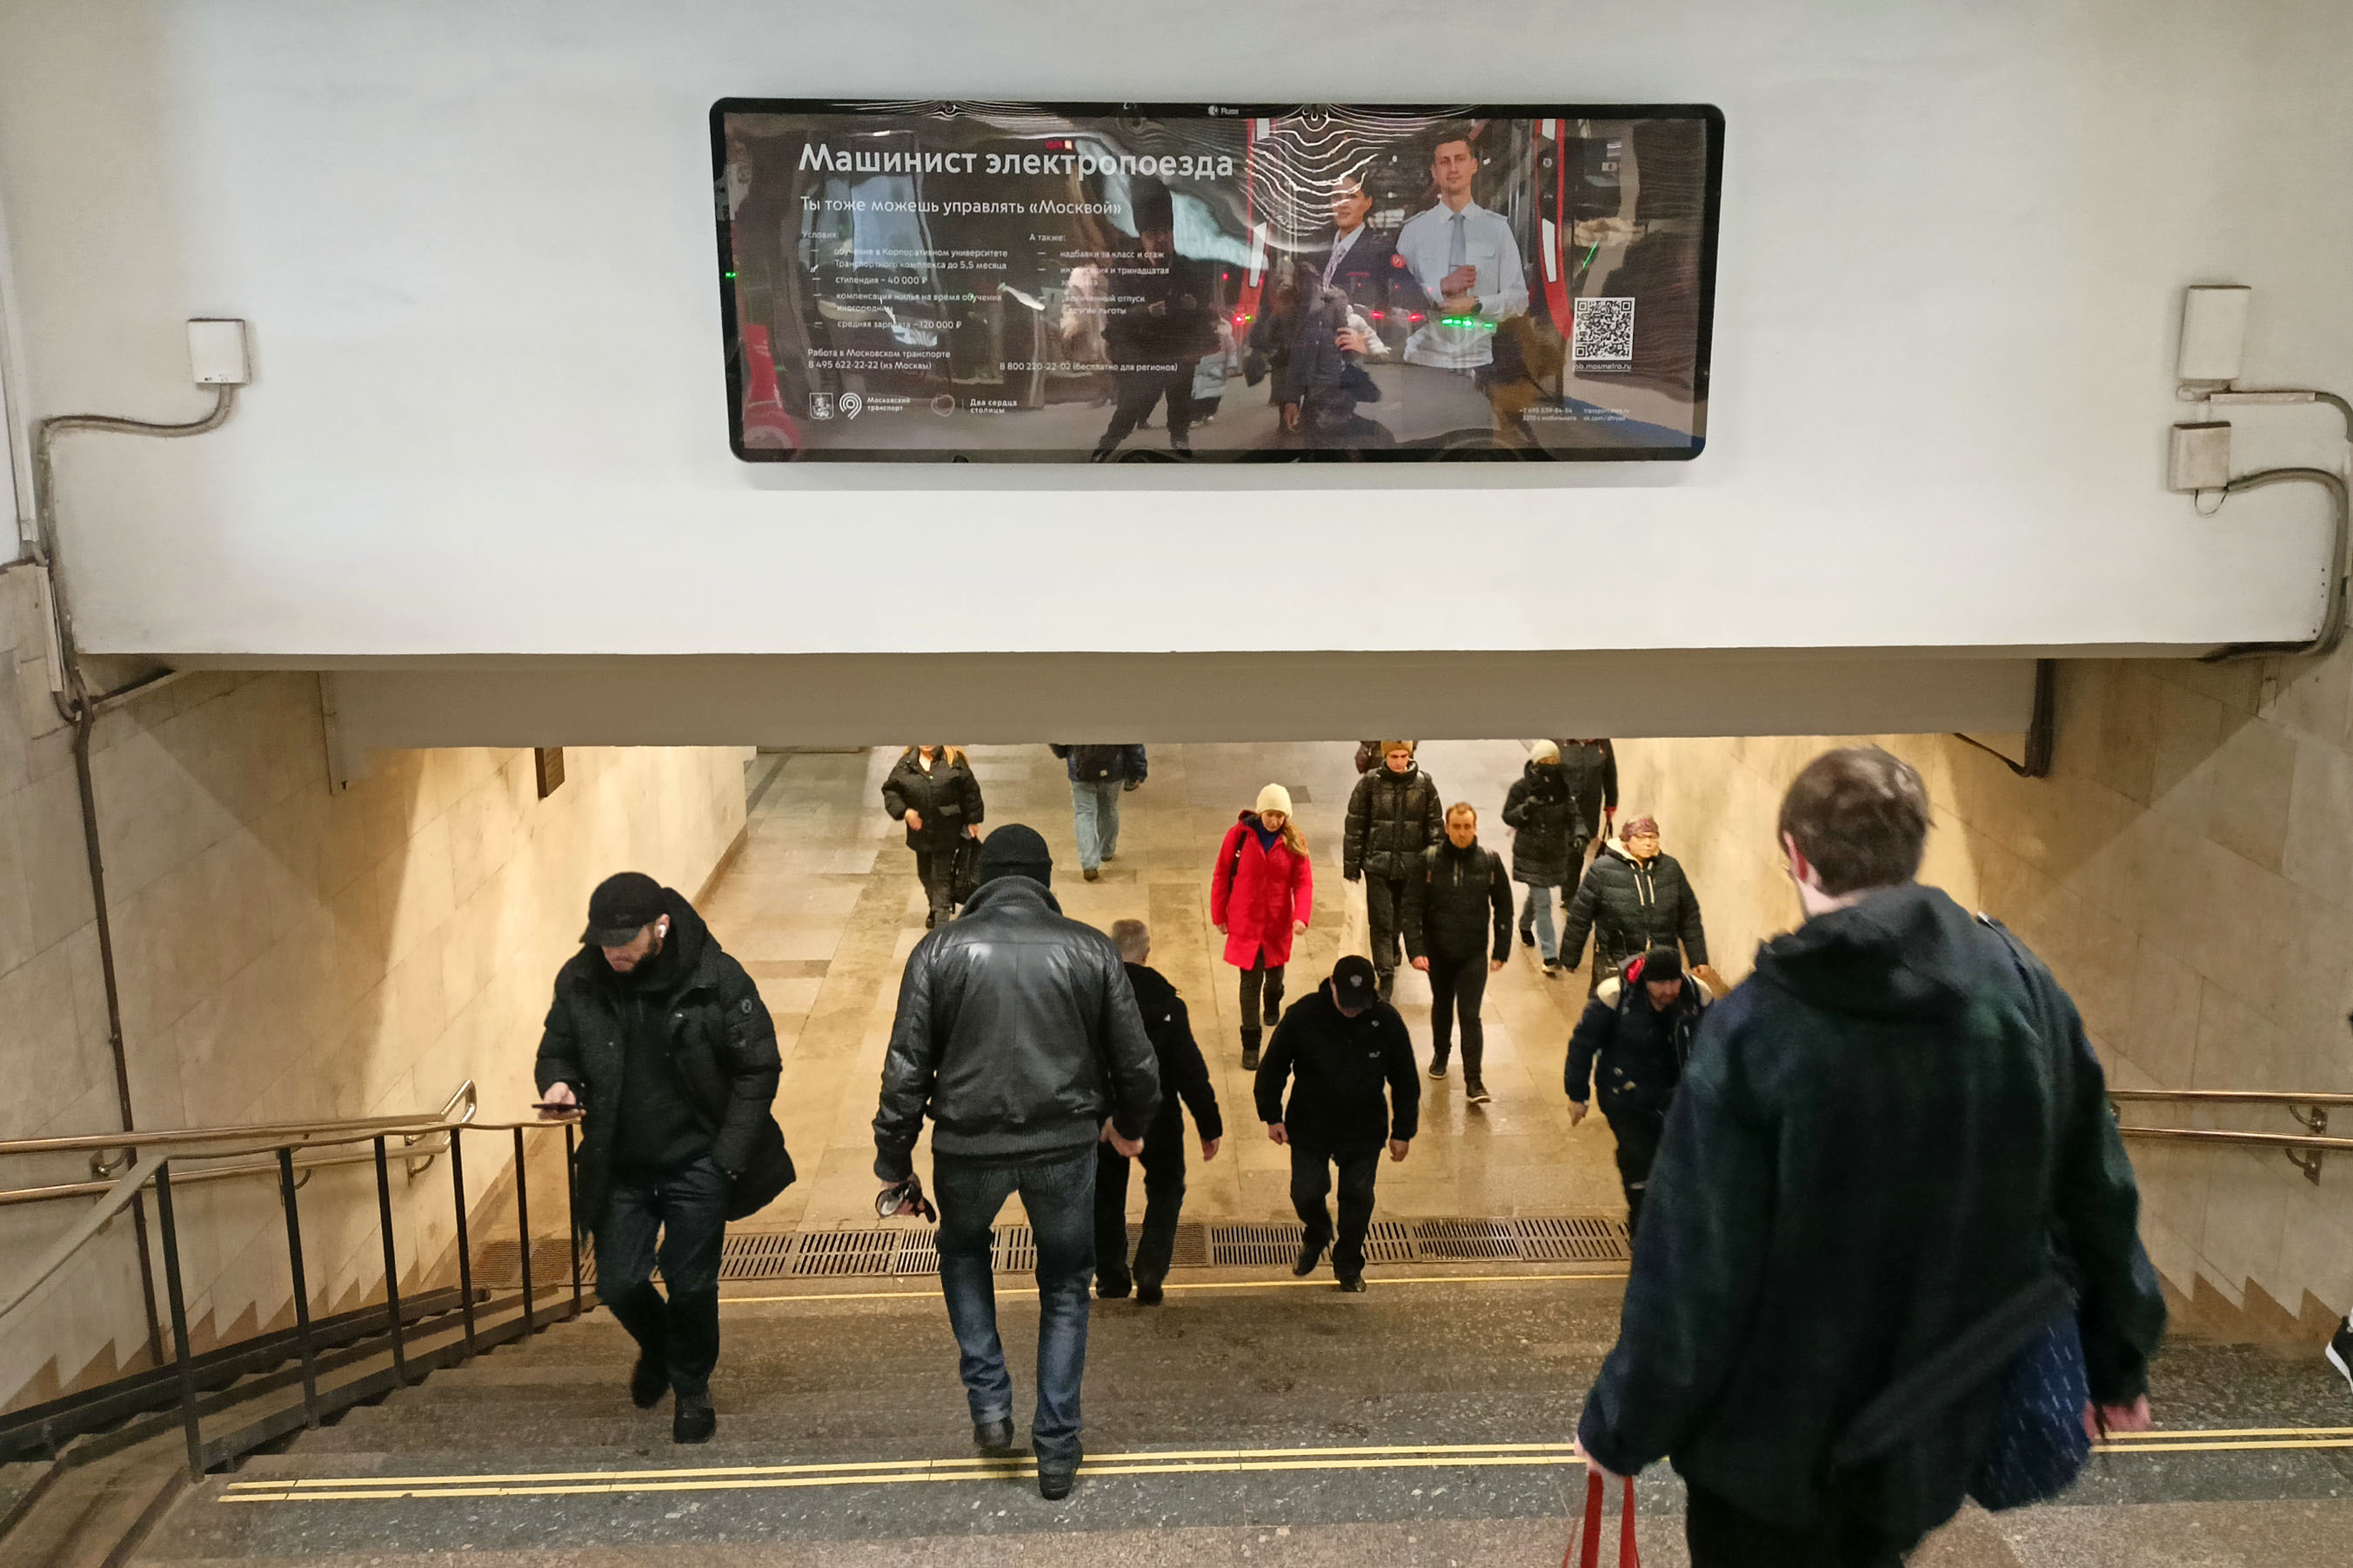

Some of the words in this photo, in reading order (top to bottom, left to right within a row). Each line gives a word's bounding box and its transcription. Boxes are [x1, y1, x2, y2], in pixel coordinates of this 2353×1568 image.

[799, 143, 978, 173] Машинист
[986, 153, 1233, 181] электропоезда
[800, 196, 820, 211] Ты
[826, 199, 866, 212] тоже
[872, 200, 939, 213] можешь
[943, 201, 1025, 216] управлять
[1030, 199, 1122, 214] «Москвой»
[1029, 233, 1036, 242] А
[882, 247, 950, 258] Корпоративном
[951, 249, 1008, 259] университете
[1060, 249, 1099, 259] надбавки
[900, 261, 946, 270] комплекса
[959, 260, 974, 270] 5,5
[975, 262, 1007, 270] месяца
[1118, 267, 1170, 276] тринадцатая
[835, 276, 879, 284] стипендия
[887, 276, 900, 284] 40
[901, 276, 919, 284] 000
[836, 292, 892, 301] компенсация
[933, 293, 960, 303] время
[961, 292, 1002, 304] обучения
[1117, 295, 1146, 304] отпуск
[837, 320, 872, 329] средняя
[873, 321, 911, 330] зарпта
[919, 320, 934, 329] 120
[936, 320, 954, 329] 000
[807, 348, 838, 357] Работа
[846, 349, 900, 358] Московском
[902, 350, 951, 359] транспорте
[880, 361, 893, 370] (из
[894, 361, 933, 370] Москвы)
[999, 362, 1006, 370] 8
[1007, 362, 1025, 370] 800
[1026, 362, 1071, 370] 220-22-02
[1073, 362, 1119, 371] (бесплатно
[1120, 364, 1135, 372] для
[1136, 362, 1178, 372] регионов)
[867, 396, 911, 404] Московский
[970, 398, 986, 407] Два
